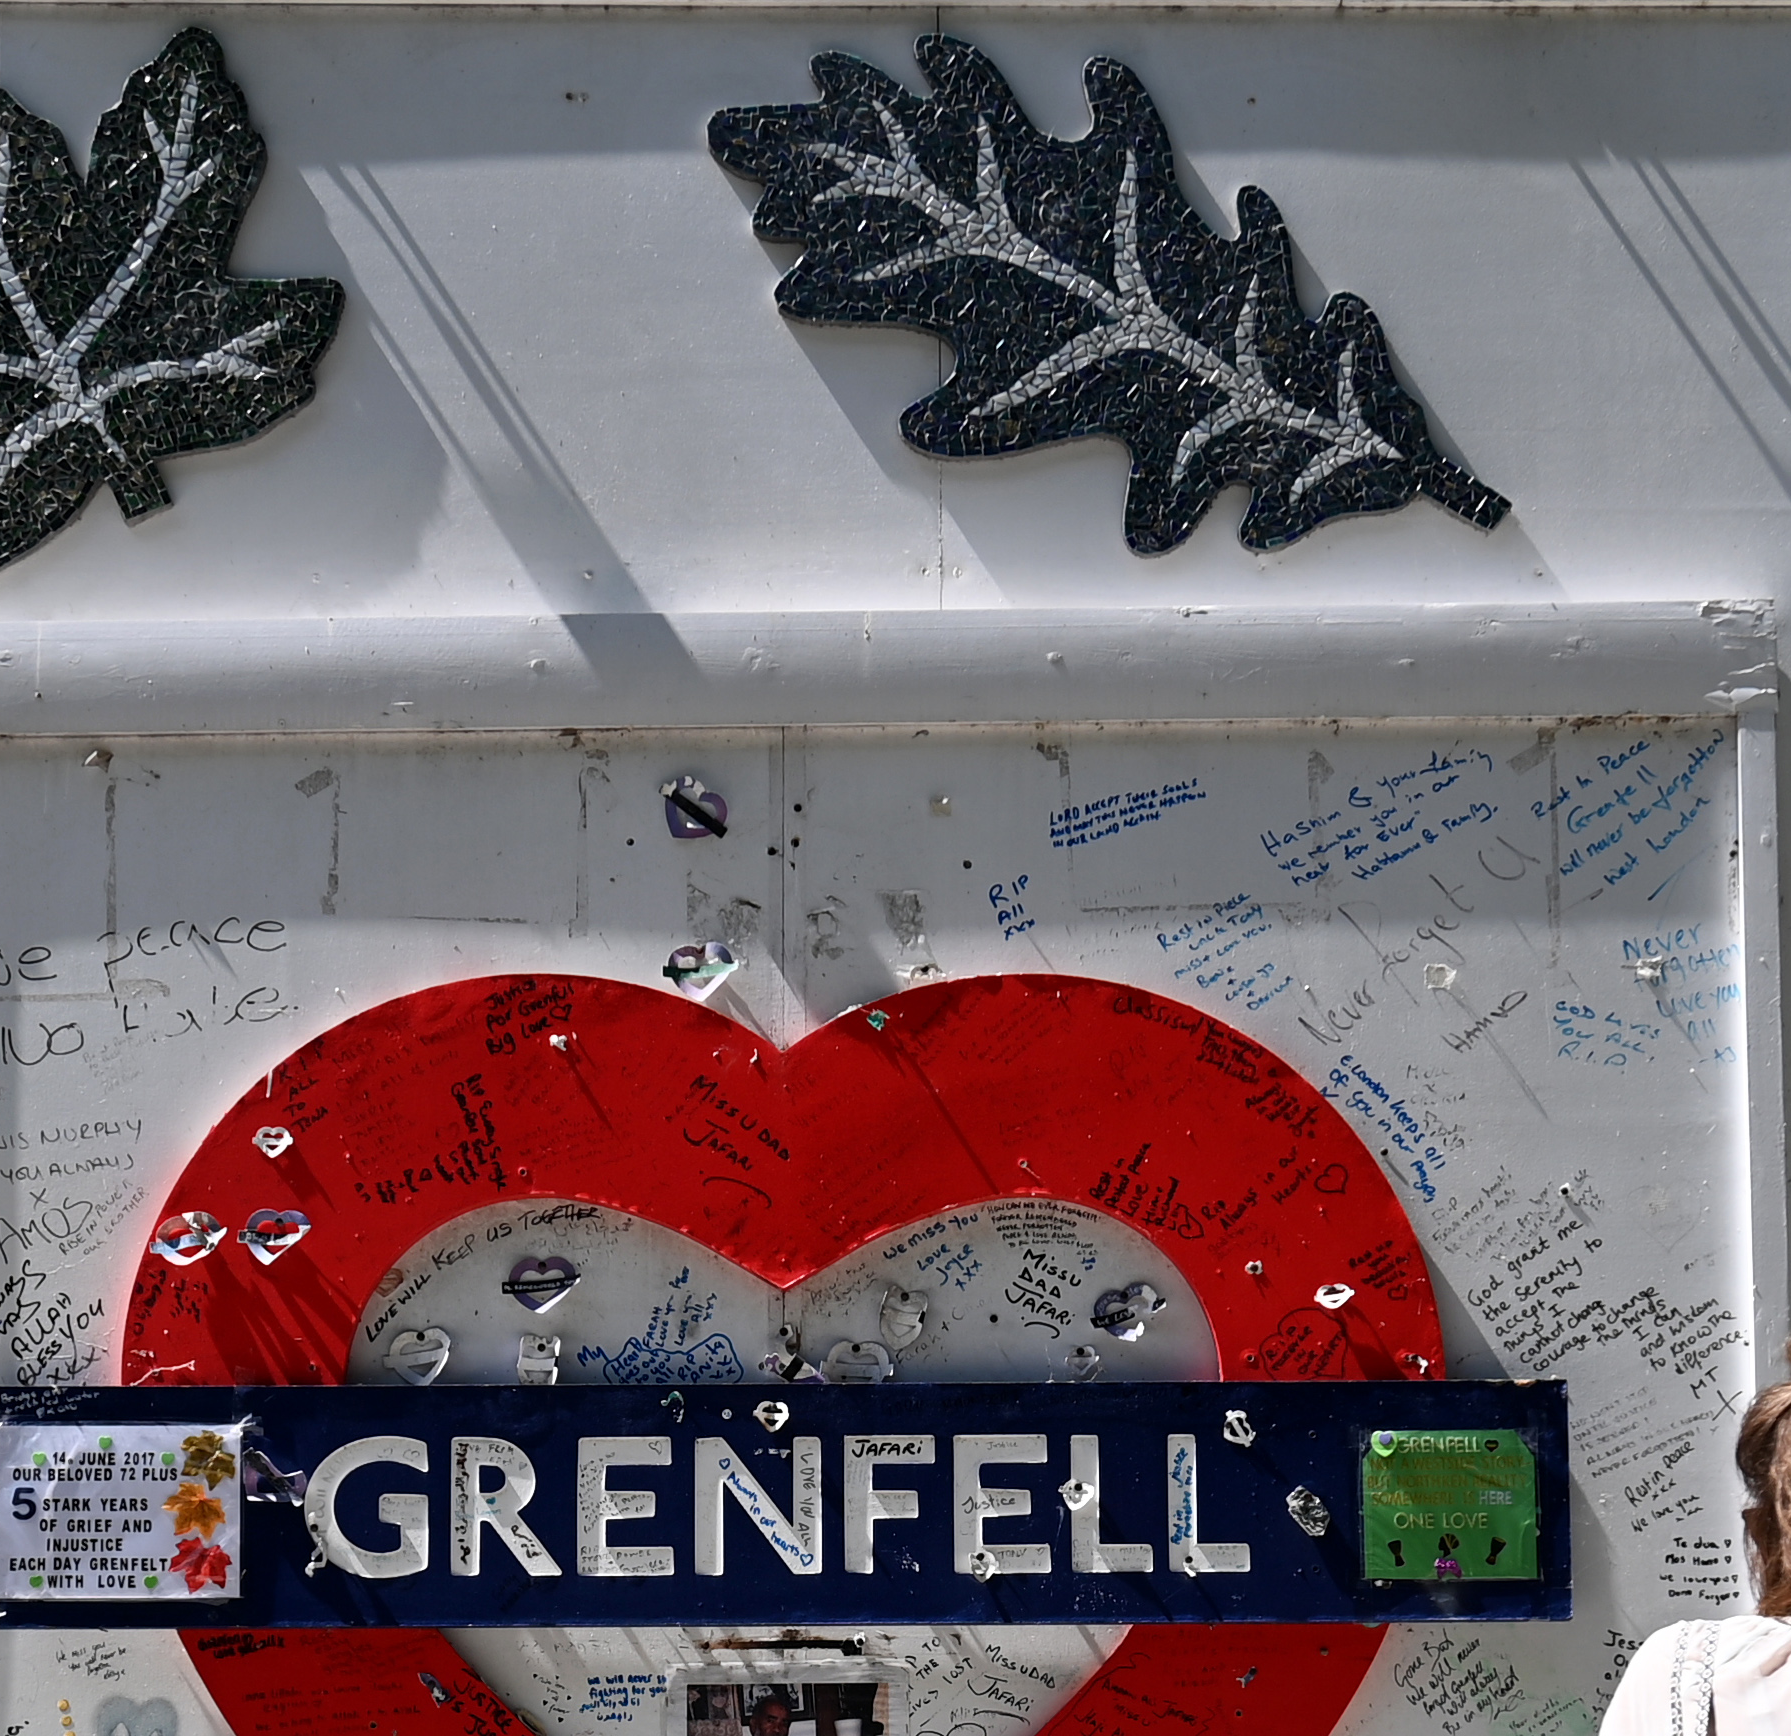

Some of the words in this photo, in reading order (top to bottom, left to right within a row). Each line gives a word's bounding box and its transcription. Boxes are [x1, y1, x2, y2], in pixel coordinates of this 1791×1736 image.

[989, 874, 1029, 908] RIP
[97, 916, 287, 1009] peace
[1398, 1436, 1481, 1453] GRENFELL
[79, 1453, 116, 1465] JUNE
[124, 1453, 155, 1465] 2017
[13, 1468, 42, 1481] OUR
[48, 1468, 113, 1481] BELOVED
[121, 1468, 135, 1481] 72
[142, 1468, 178, 1481] PLUS
[11, 1487, 37, 1520] 5
[42, 1498, 91, 1511] STARK
[101, 1498, 148, 1511] YEARS
[303, 1432, 1252, 1578] GRENFELL
[1479, 1491, 1513, 1505] HERE
[39, 1519, 57, 1532] OF
[67, 1519, 113, 1533] GRIEF
[122, 1519, 152, 1533] AND
[1394, 1512, 1434, 1529] ONE
[1443, 1512, 1489, 1529] LOVE
[47, 1538, 123, 1552] INJUSTICE
[10, 1557, 46, 1571] EACH
[53, 1557, 81, 1571] DAY
[90, 1557, 168, 1572] GRENFELT
[48, 1575, 84, 1588] WITH
[98, 1575, 136, 1588] LOVE
